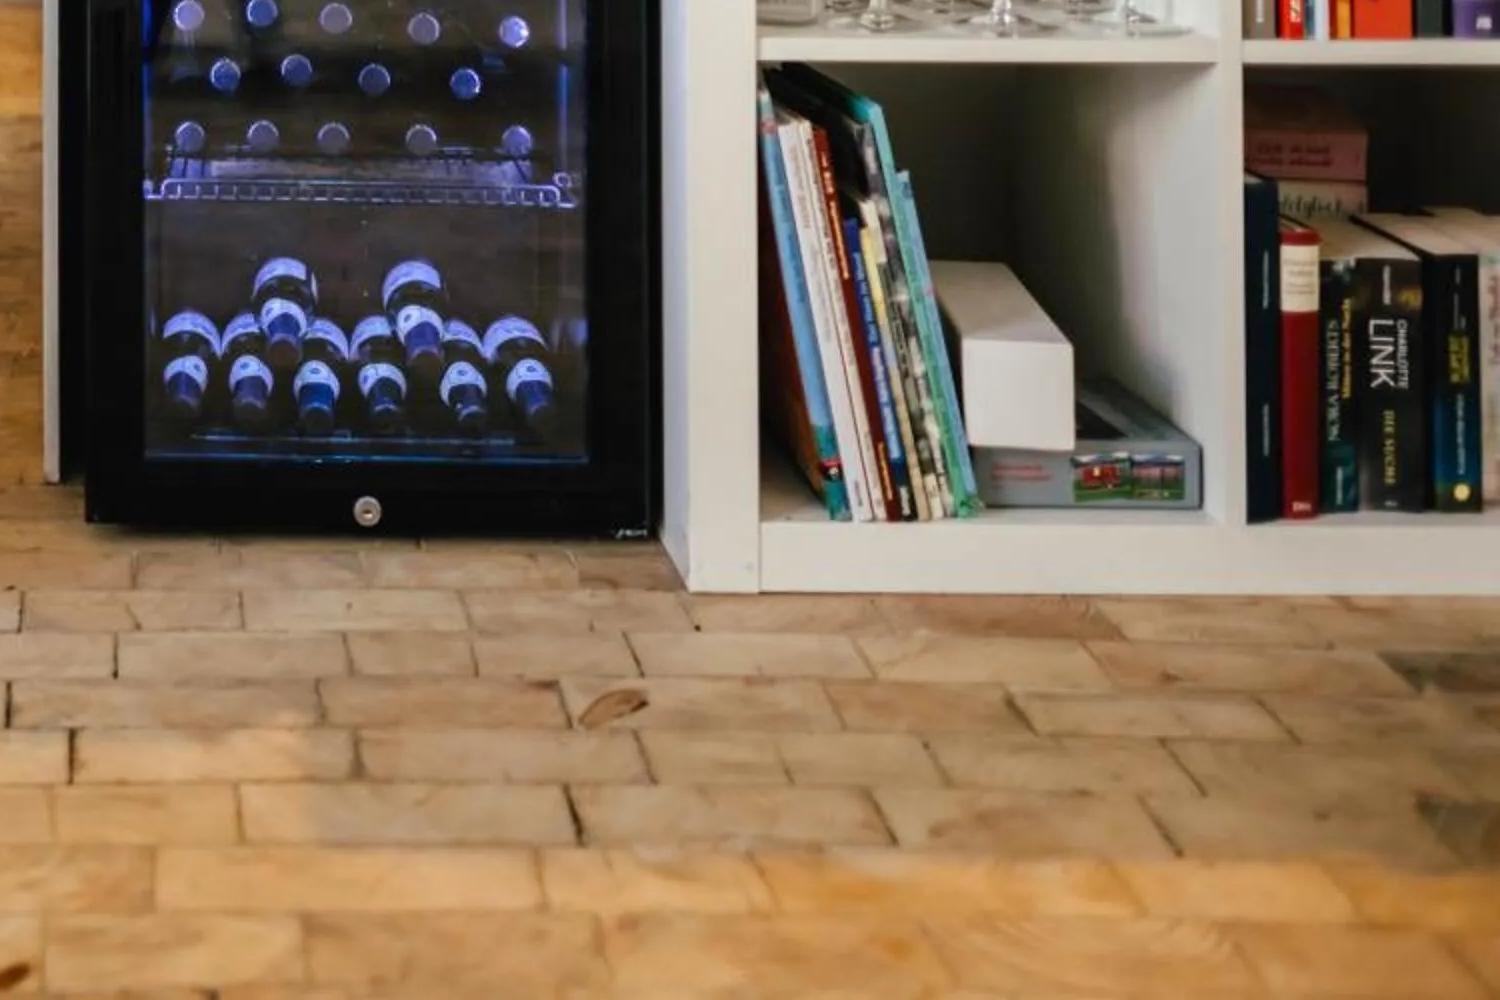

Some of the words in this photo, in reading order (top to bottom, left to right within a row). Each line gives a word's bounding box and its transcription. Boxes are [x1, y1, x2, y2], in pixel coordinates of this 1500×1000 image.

[1326, 318, 1341, 390] ROBERTS
[1368, 318, 1397, 389] LINK
[1396, 319, 1409, 390] CHARLOTTE
[1327, 394, 1342, 441] NORA
